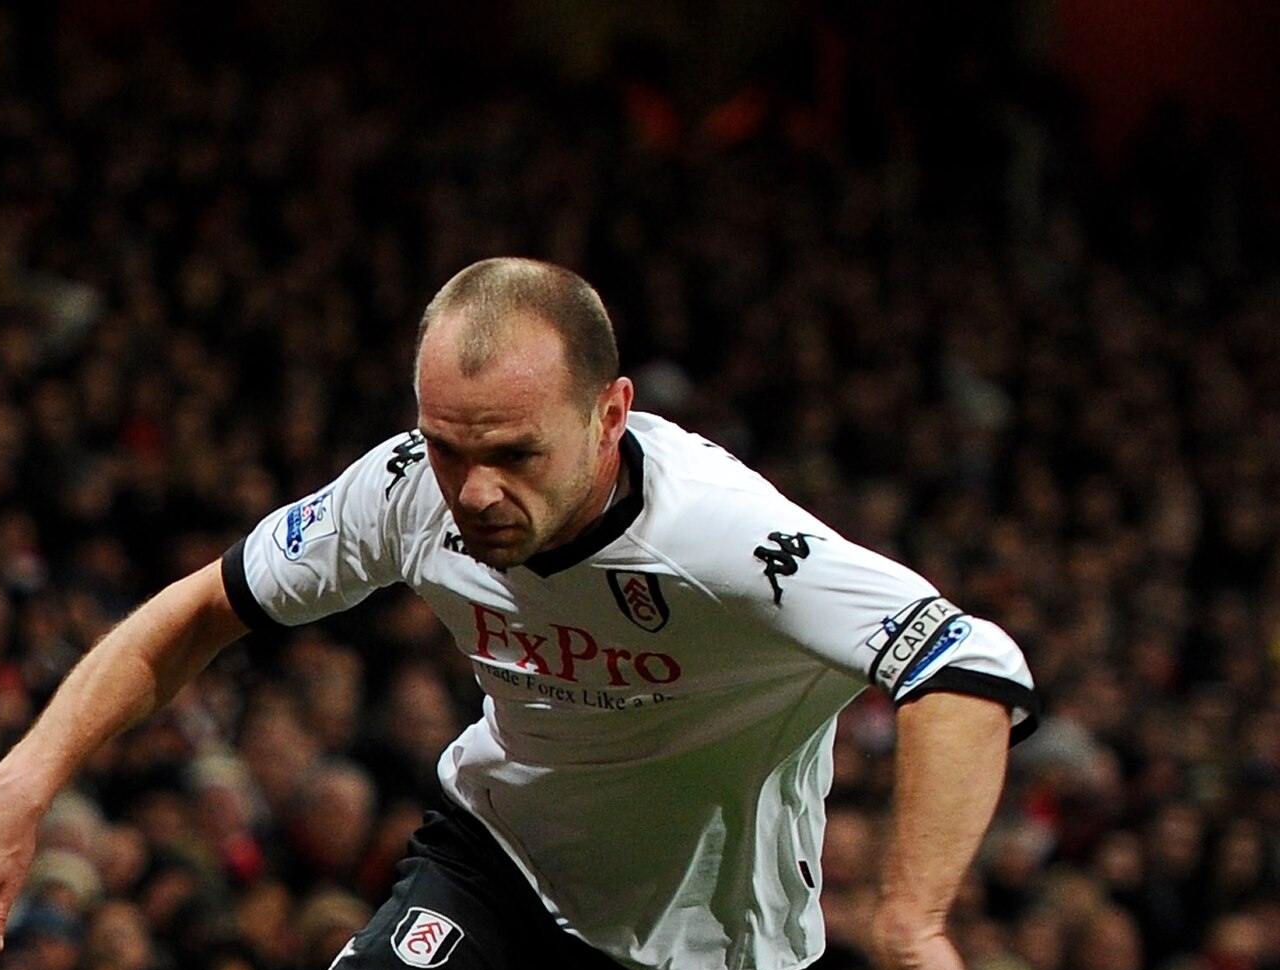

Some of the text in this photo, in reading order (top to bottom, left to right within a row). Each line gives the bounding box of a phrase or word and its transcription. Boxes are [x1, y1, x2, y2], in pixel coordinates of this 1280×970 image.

[469, 602, 682, 687] FxPro
[892, 602, 950, 662] CAPTA
[525, 675, 576, 703] Forex
[583, 689, 626, 710] Like
[406, 921, 444, 955] FFC
